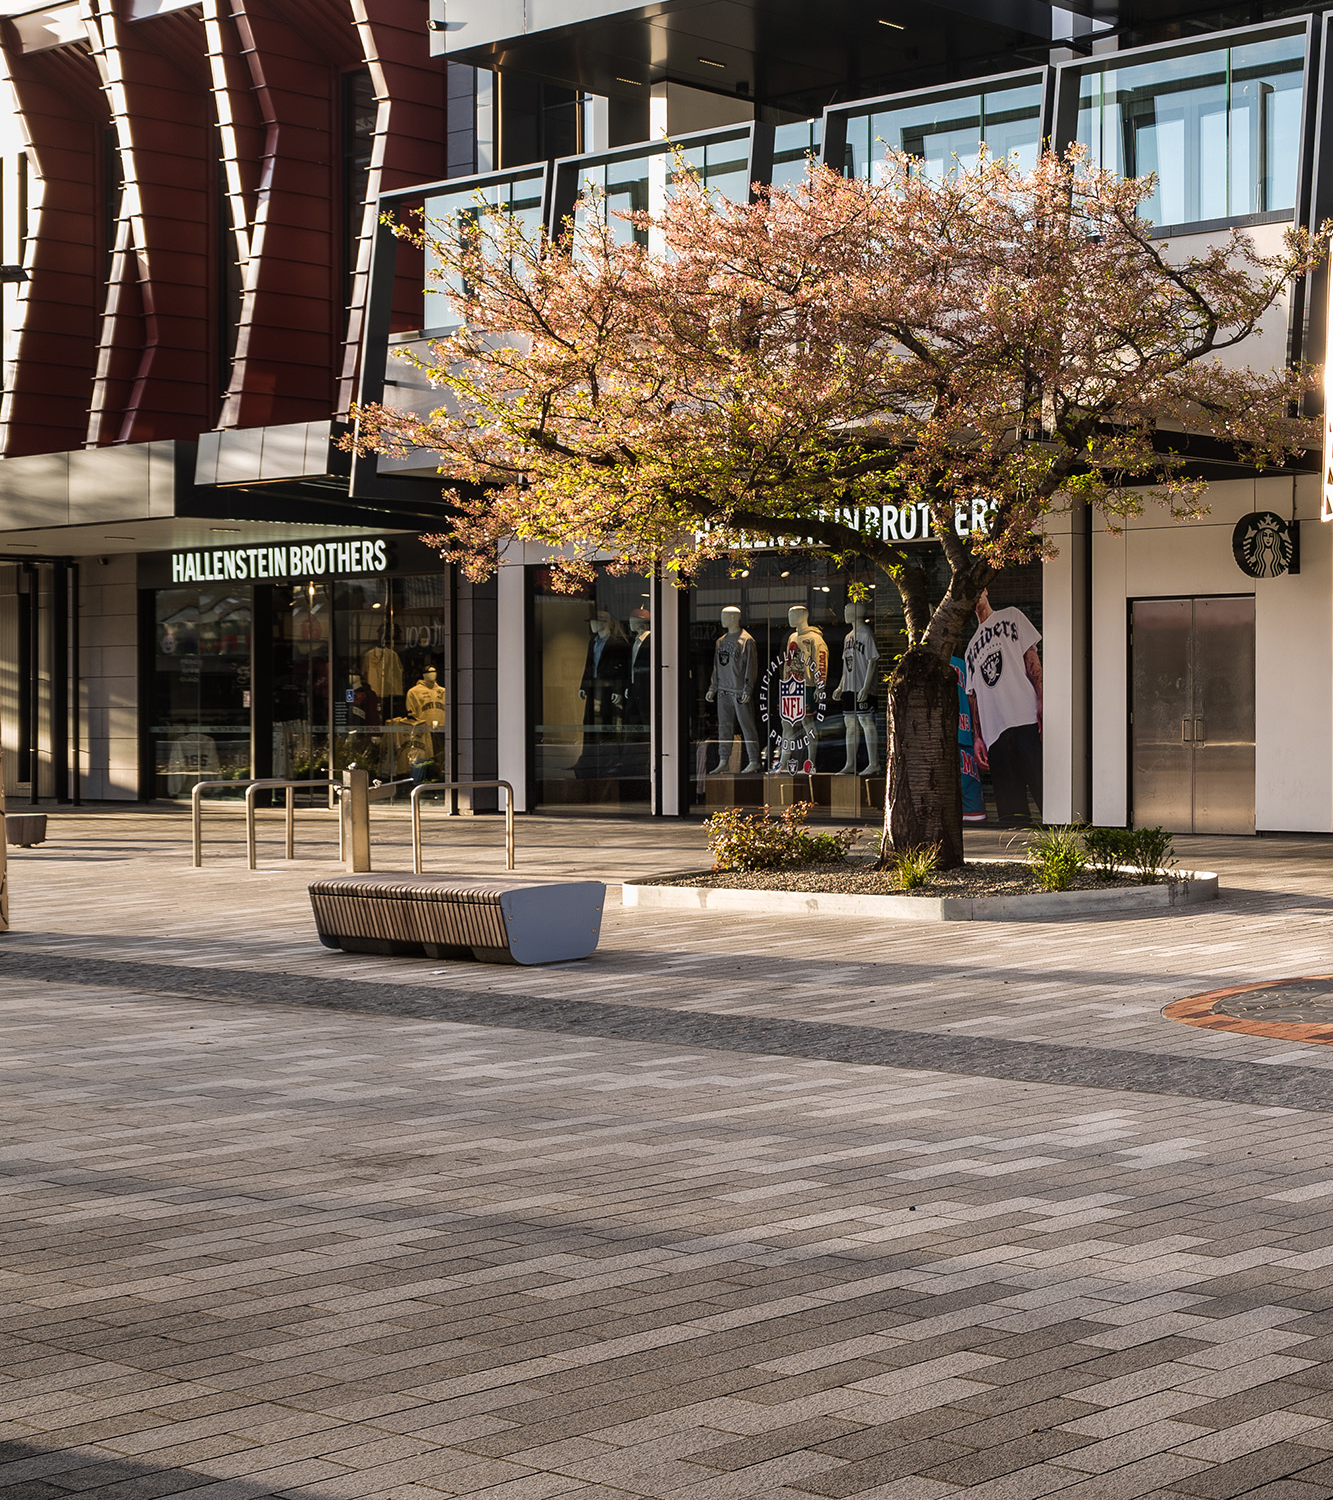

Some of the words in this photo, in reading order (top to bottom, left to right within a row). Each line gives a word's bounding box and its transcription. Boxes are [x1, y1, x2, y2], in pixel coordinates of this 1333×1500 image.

[172, 547, 287, 583] HALLENSTEIN
[290, 540, 387, 576] BROTHERS
[759, 650, 795, 722] OFFICIALLY
[800, 654, 827, 722] LICENSED
[782, 696, 803, 718] NFL
[769, 729, 816, 751] PRODUCT
